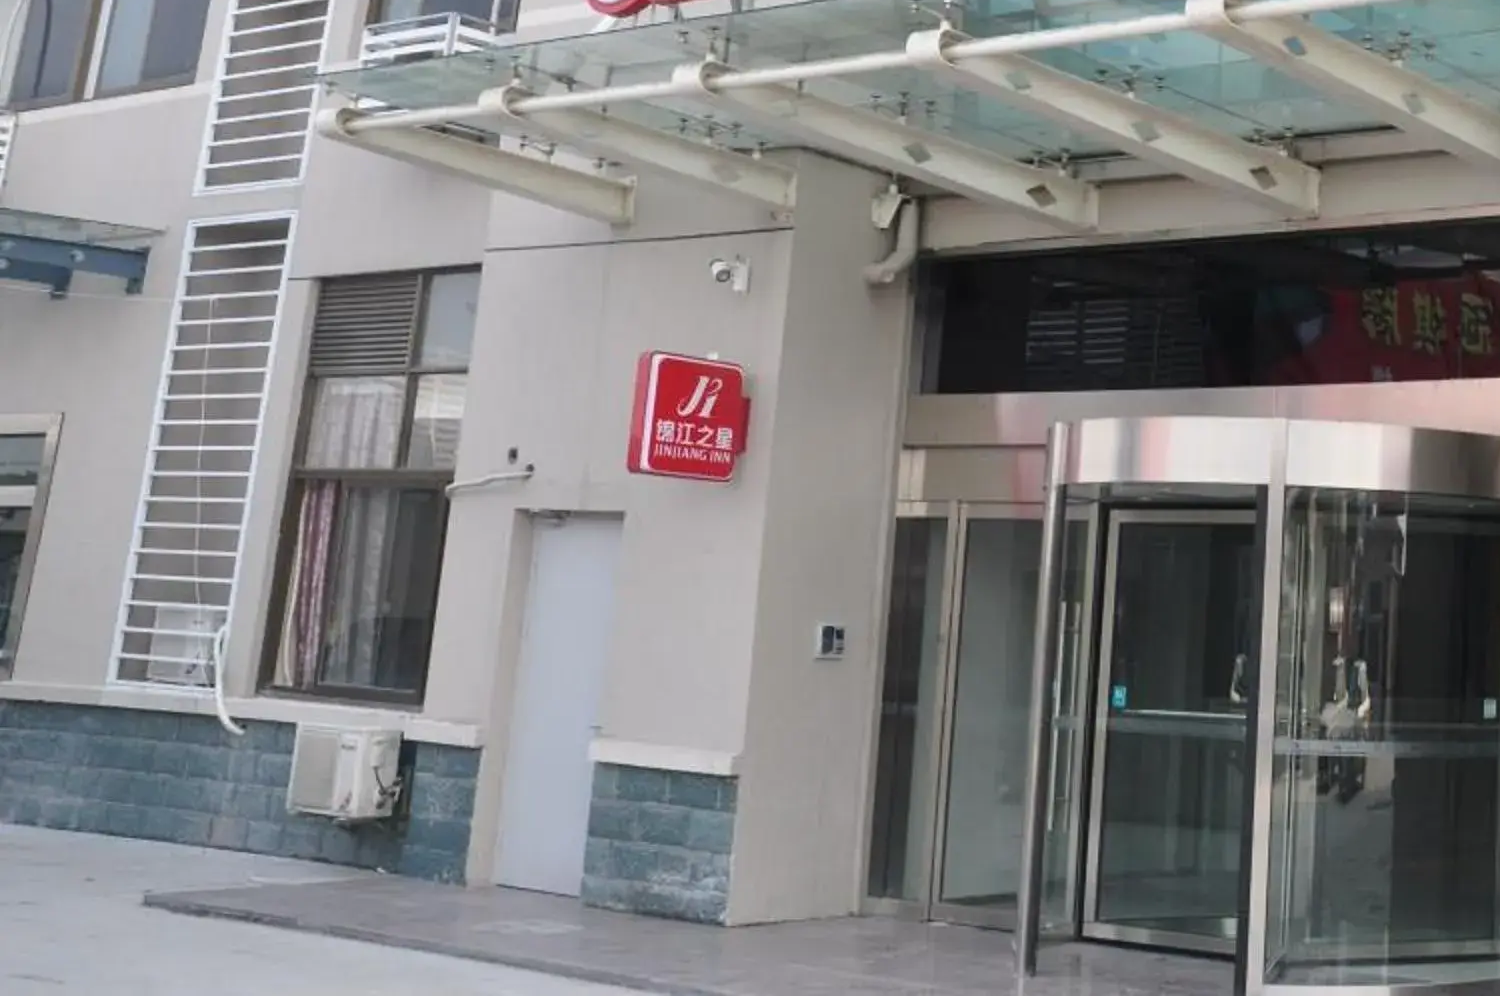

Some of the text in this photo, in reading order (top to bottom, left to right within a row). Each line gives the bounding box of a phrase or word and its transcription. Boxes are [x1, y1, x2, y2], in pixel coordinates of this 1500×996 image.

[655, 418, 733, 450] 锦江之星
[654, 443, 731, 464] JINJIANG INN
